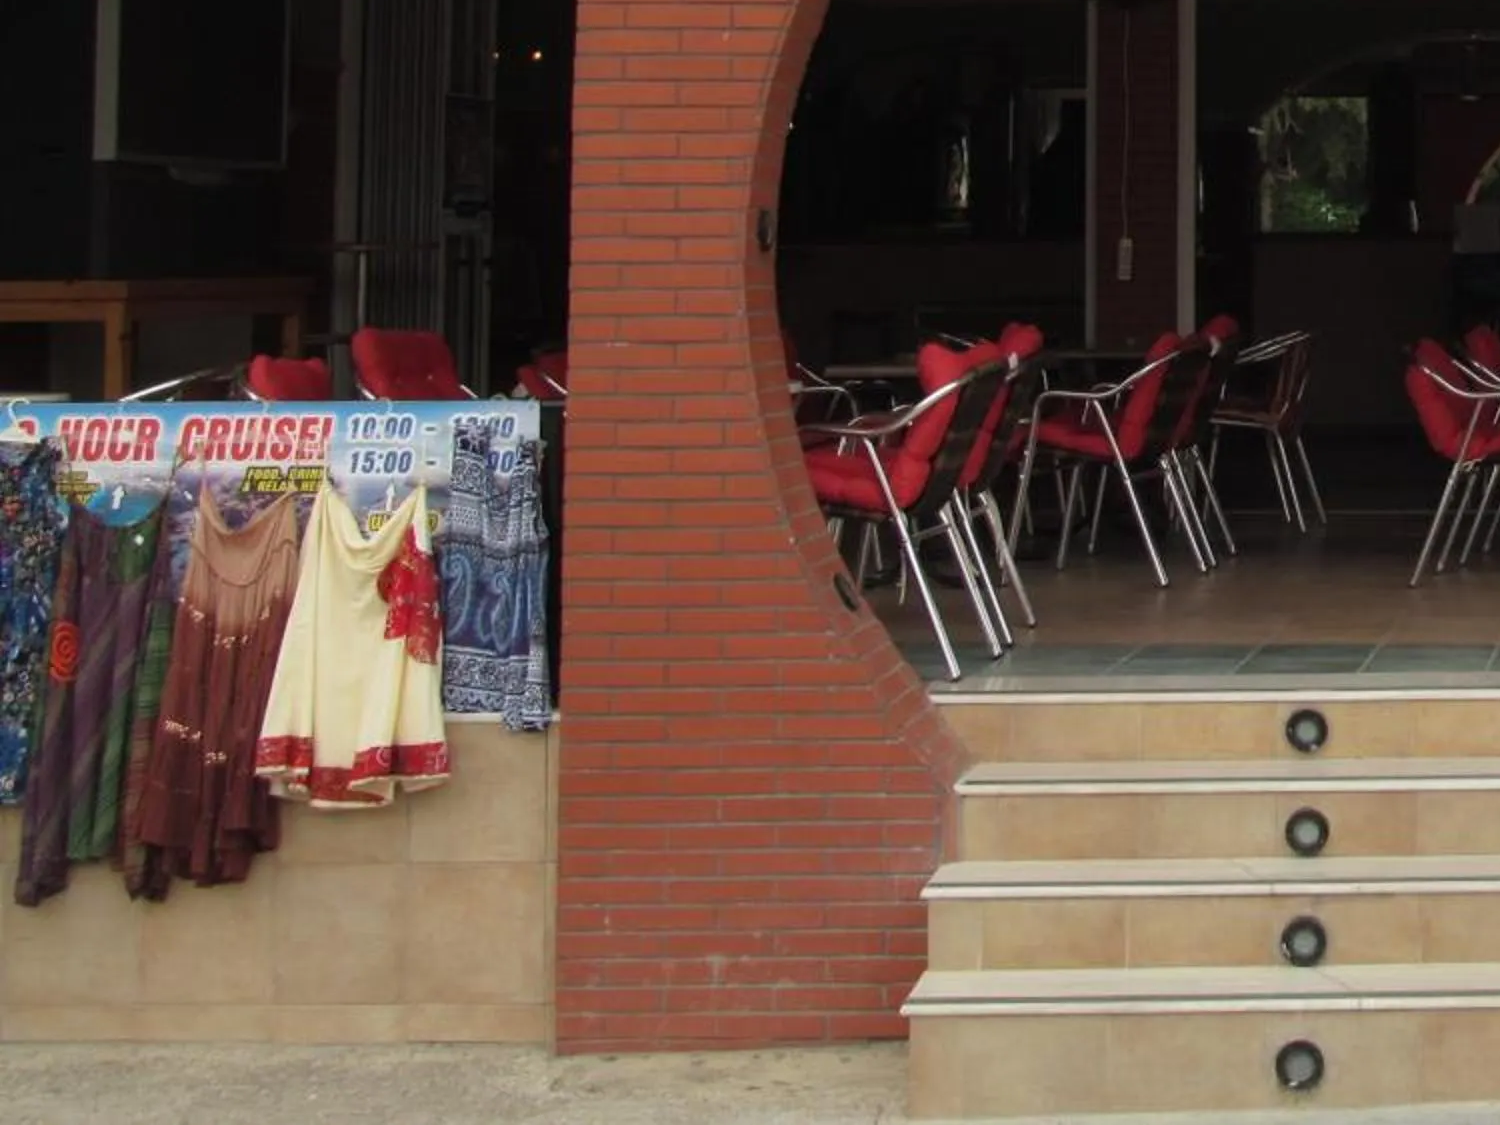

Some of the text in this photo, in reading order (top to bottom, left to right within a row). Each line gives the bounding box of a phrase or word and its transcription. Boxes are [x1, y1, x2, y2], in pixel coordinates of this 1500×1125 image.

[180, 416, 335, 461] CRUISE!
[351, 416, 414, 441] 10:00
[351, 450, 413, 474] 15:00
